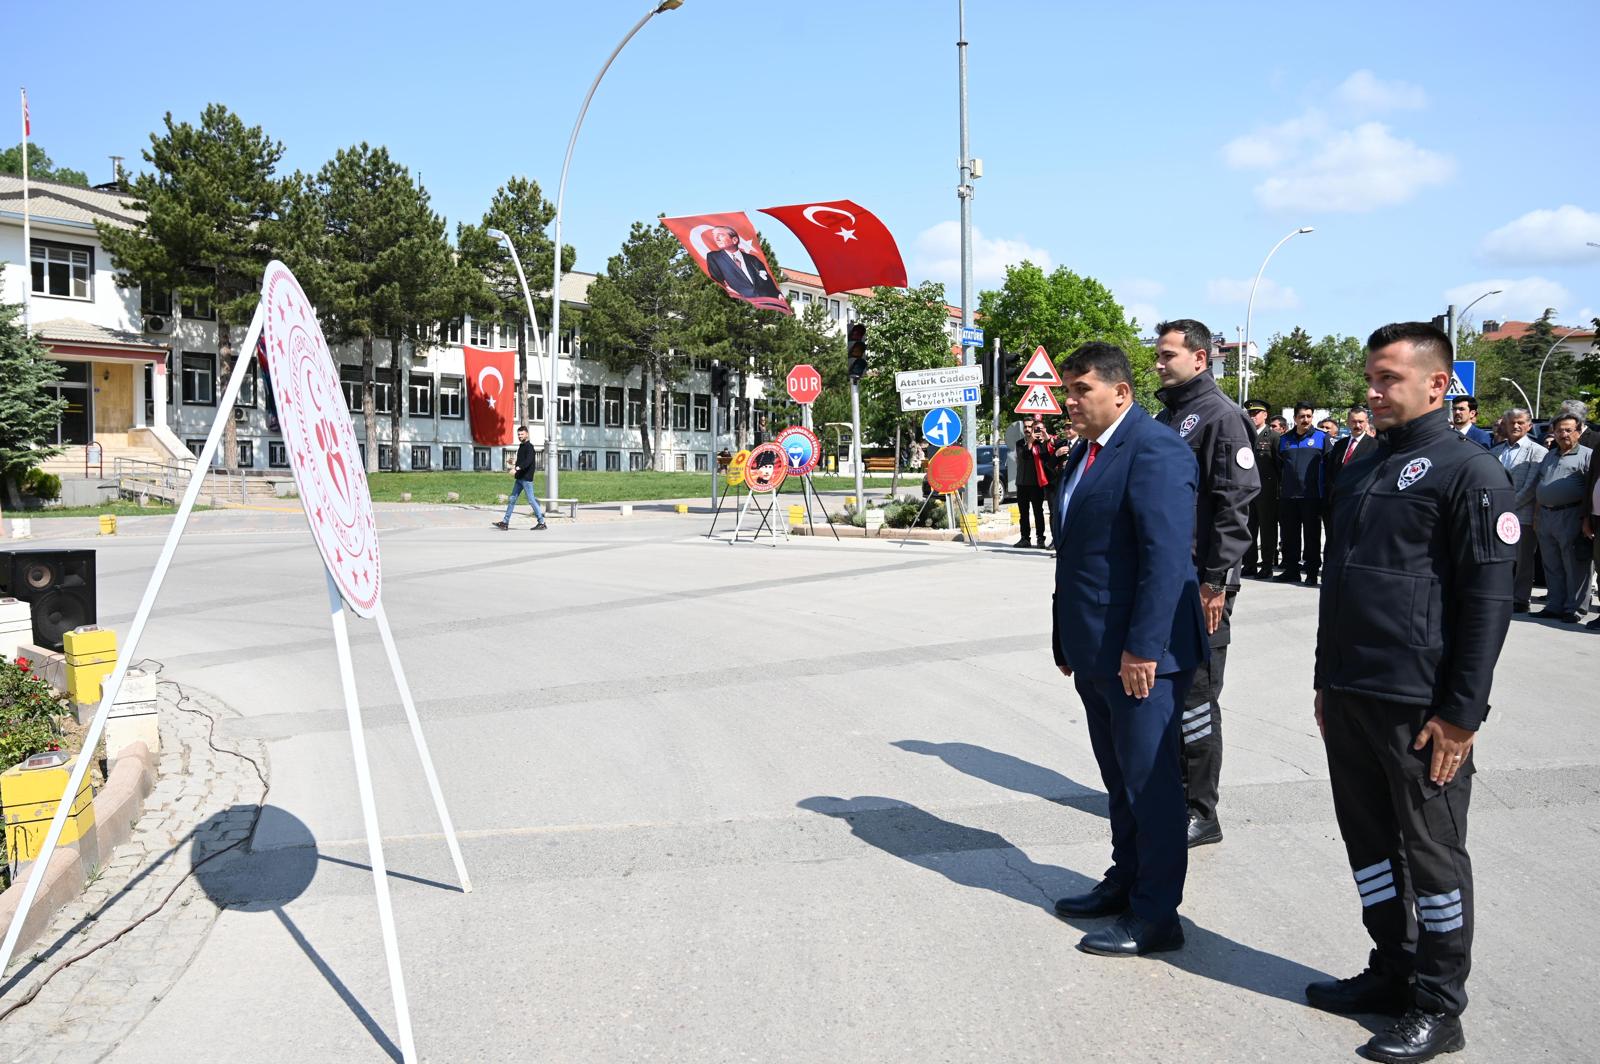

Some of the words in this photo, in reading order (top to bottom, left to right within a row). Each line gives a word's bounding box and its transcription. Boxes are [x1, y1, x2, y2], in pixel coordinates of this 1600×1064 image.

[790, 377, 819, 392] DUR
[900, 377, 937, 387] Atatürk
[940, 373, 979, 384] Caddesi
[916, 390, 962, 400] Seydişehir
[917, 398, 945, 407] Devlet
